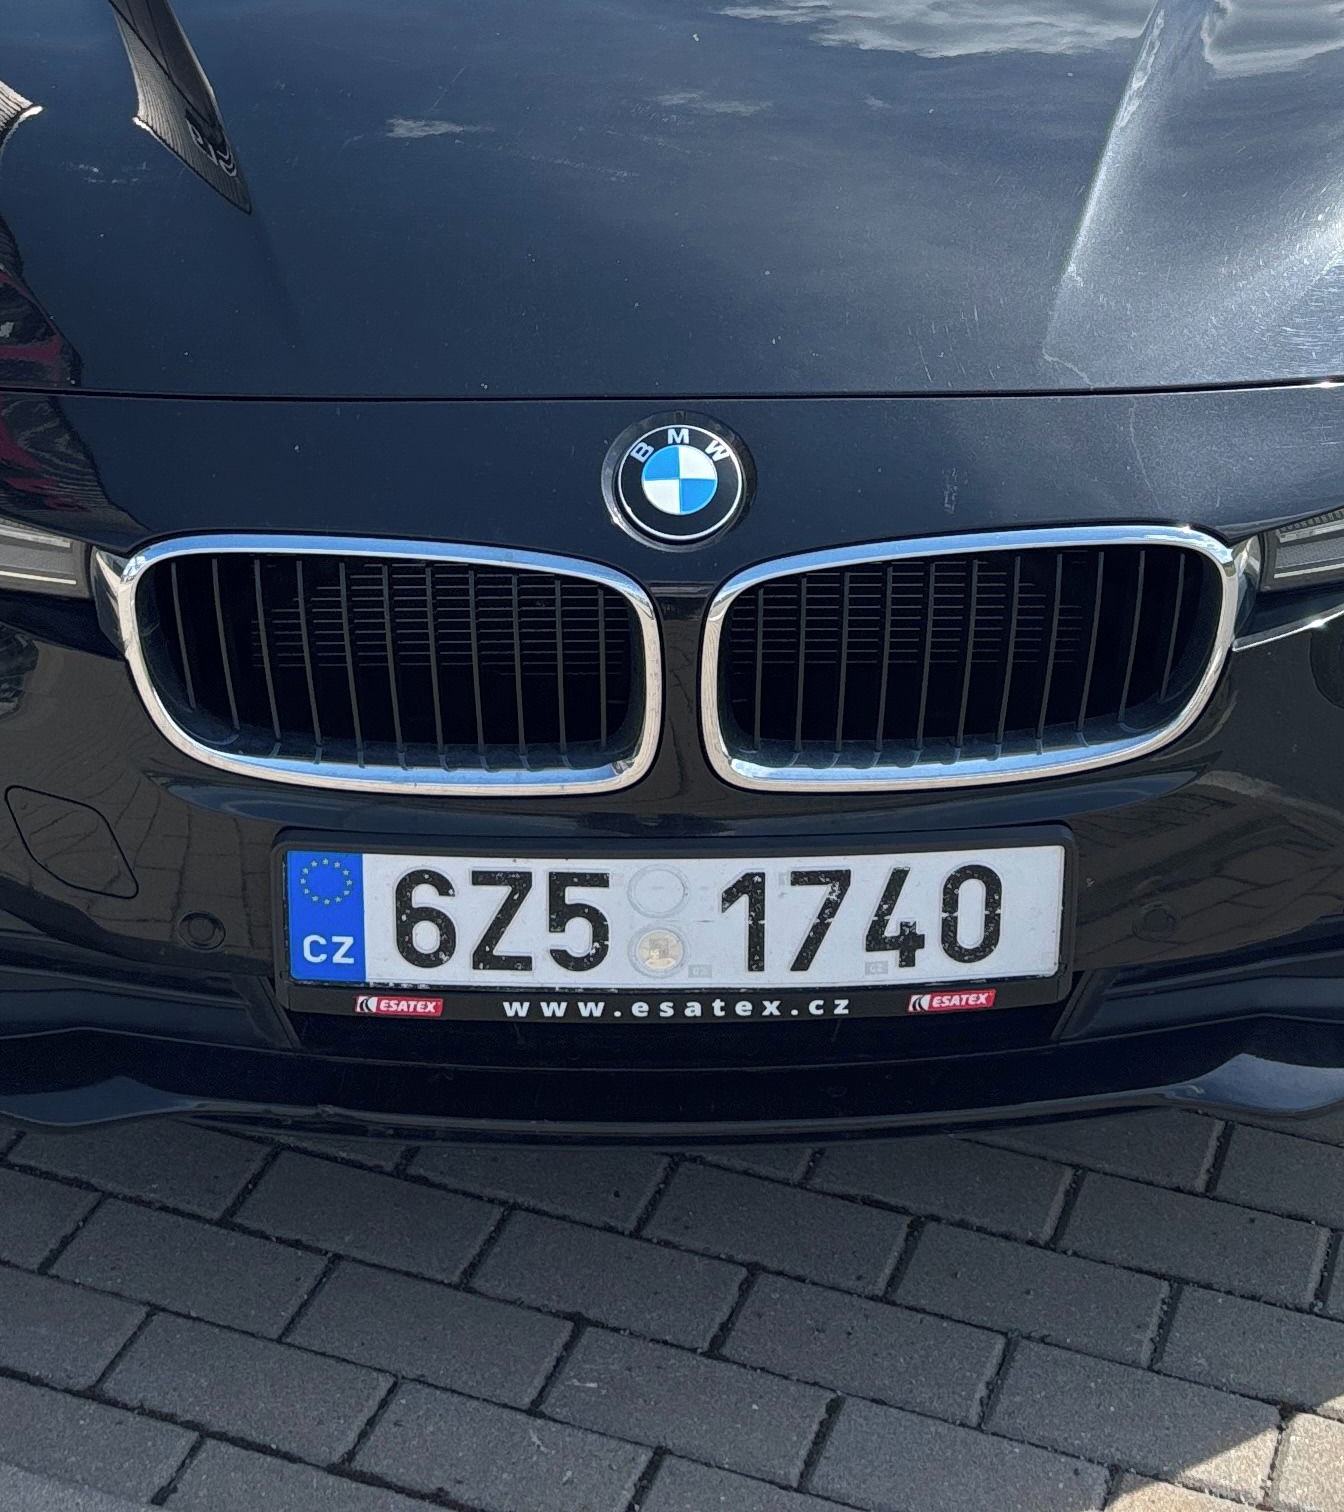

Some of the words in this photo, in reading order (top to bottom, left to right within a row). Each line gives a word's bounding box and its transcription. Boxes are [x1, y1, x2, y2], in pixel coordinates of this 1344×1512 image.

[630, 428, 730, 463] BMW
[394, 868, 609, 971] 6Z5
[721, 864, 1002, 972] 1740
[303, 934, 355, 964] CZ
[379, 999, 437, 1013] ESATEX
[502, 996, 849, 1018] www.esatex.cz
[931, 993, 989, 1008] ESATEX
